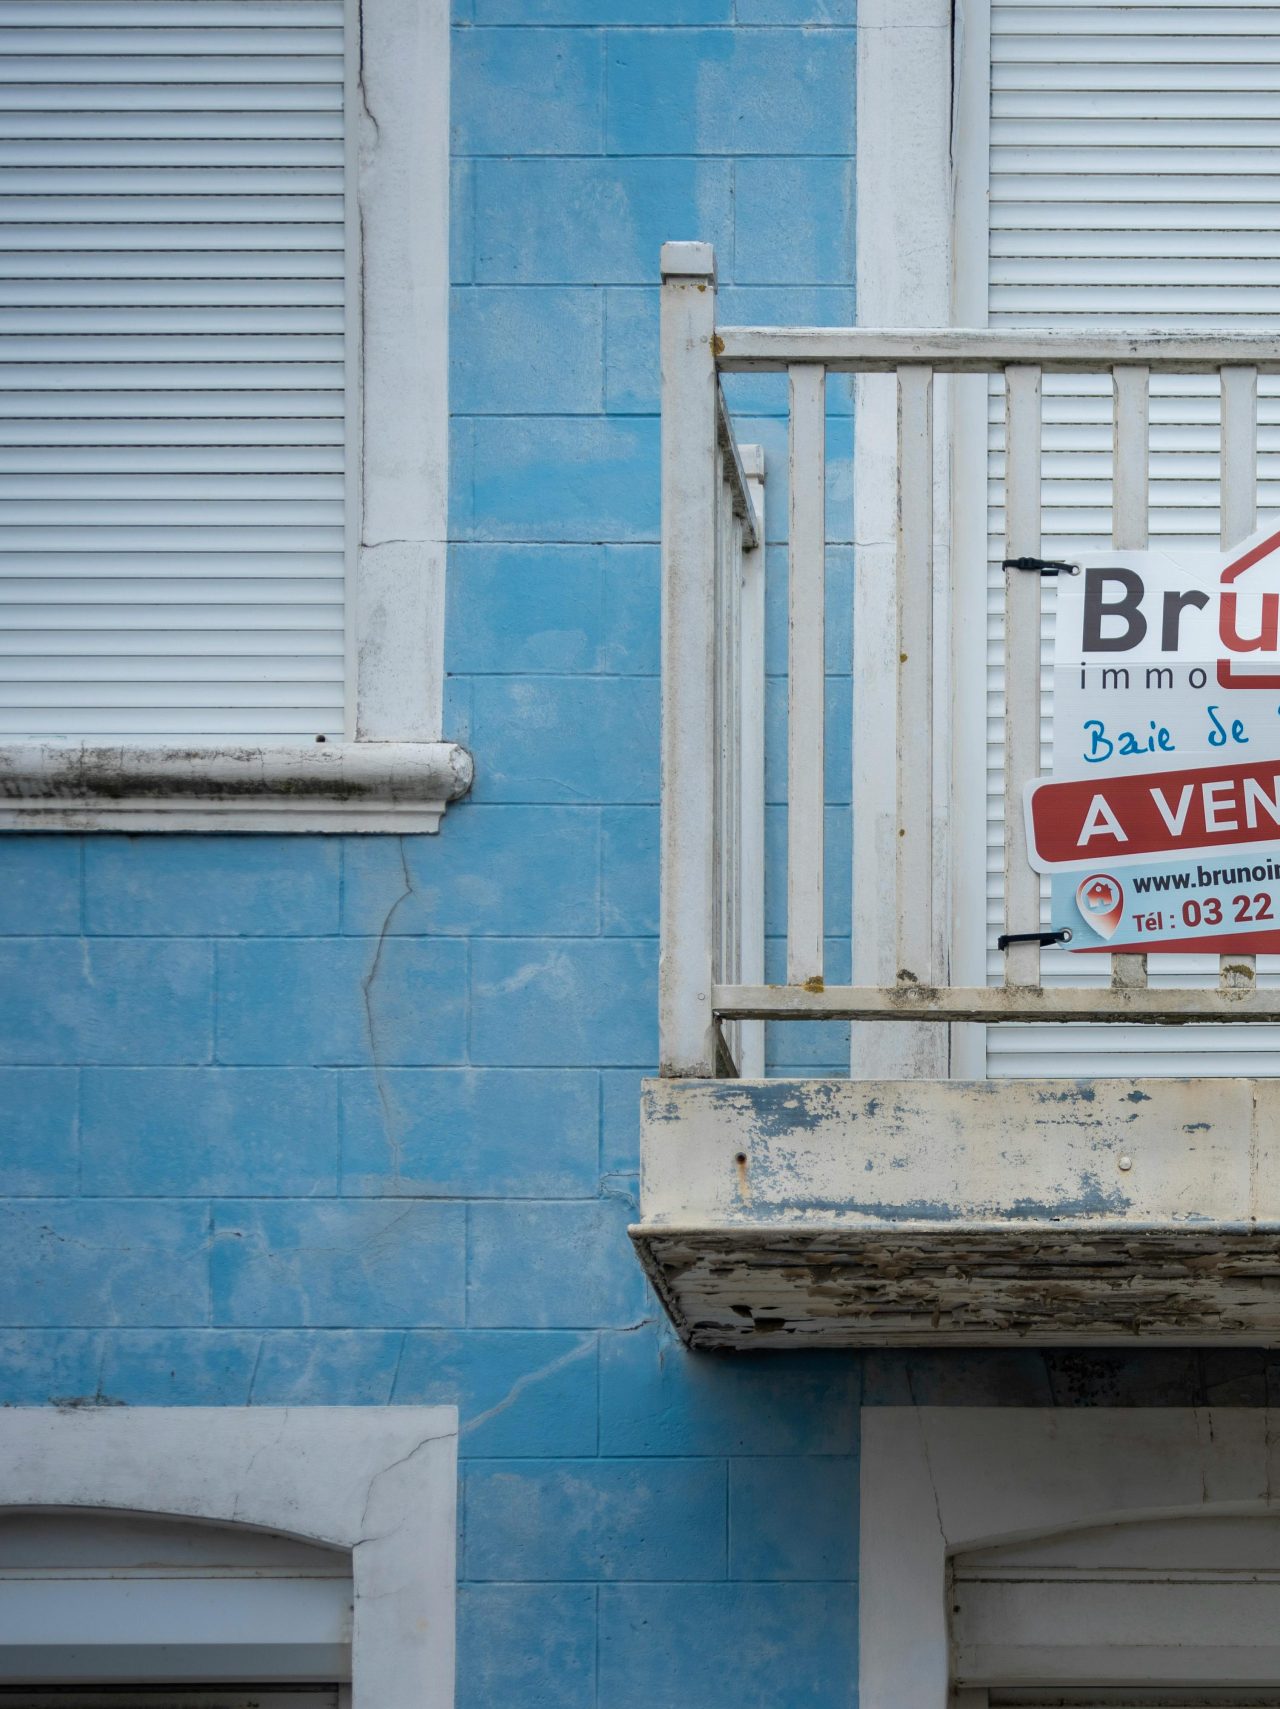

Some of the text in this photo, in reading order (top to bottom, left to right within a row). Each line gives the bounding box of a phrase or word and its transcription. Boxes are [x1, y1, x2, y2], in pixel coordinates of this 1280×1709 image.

[1080, 662, 1207, 689] immo
[1084, 720, 1175, 762] Baie
[1207, 706, 1249, 746] de
[1077, 794, 1128, 846] A
[1182, 899, 1223, 928] 03
[1233, 894, 1274, 923] 22
